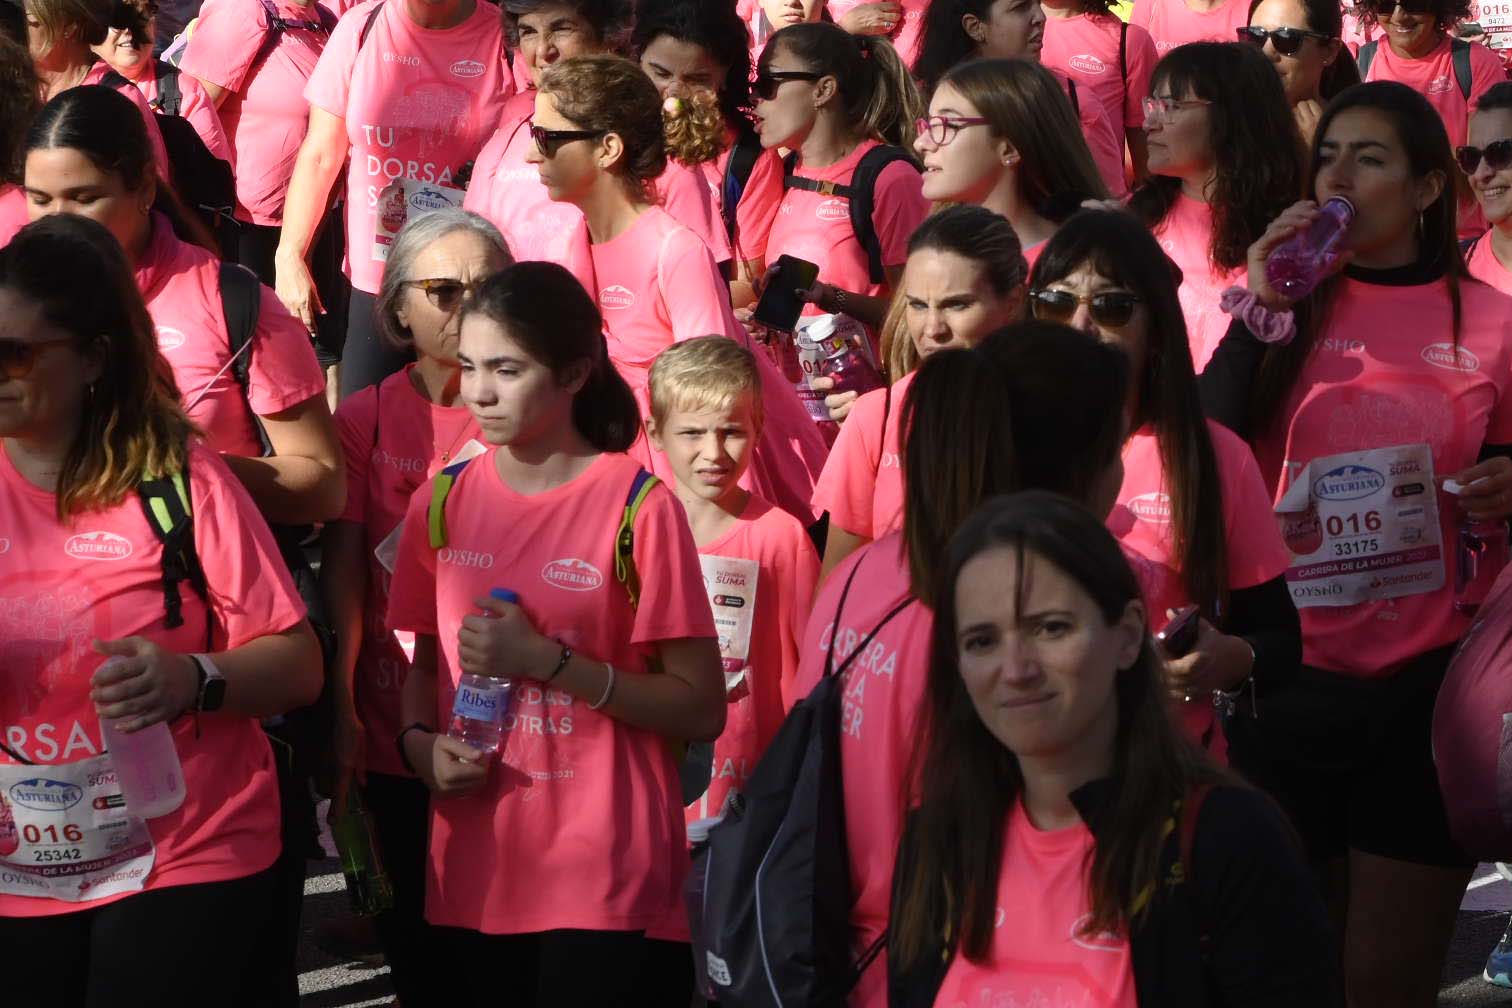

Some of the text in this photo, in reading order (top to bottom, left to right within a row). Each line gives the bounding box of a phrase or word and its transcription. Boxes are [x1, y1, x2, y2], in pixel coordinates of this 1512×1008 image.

[1483, 3, 1510, 16] 016
[361, 124, 395, 148] TU
[367, 155, 453, 186] DORSA
[1389, 464, 1421, 476] SUMA
[1319, 479, 1380, 496] ASTURIANA
[1326, 510, 1382, 536] 016
[70, 539, 127, 555] ASTURIANA
[1334, 538, 1379, 557] 33175
[438, 547, 494, 570] OYSHO
[1298, 563, 1339, 578] CARRERA
[1341, 561, 1353, 571] DE
[1356, 559, 1369, 569] LA
[1370, 555, 1401, 568] MUJER
[545, 563, 598, 587] ASTURIANA
[715, 575, 746, 587] SUMA
[1294, 570, 1433, 598] OYSHO Santander
[461, 687, 497, 709] Ribes
[88, 774, 118, 787] SUM
[16, 788, 77, 804] ASTURIANA
[23, 823, 83, 844] 016
[34, 848, 82, 862] 25342
[91, 867, 144, 886] Santander
